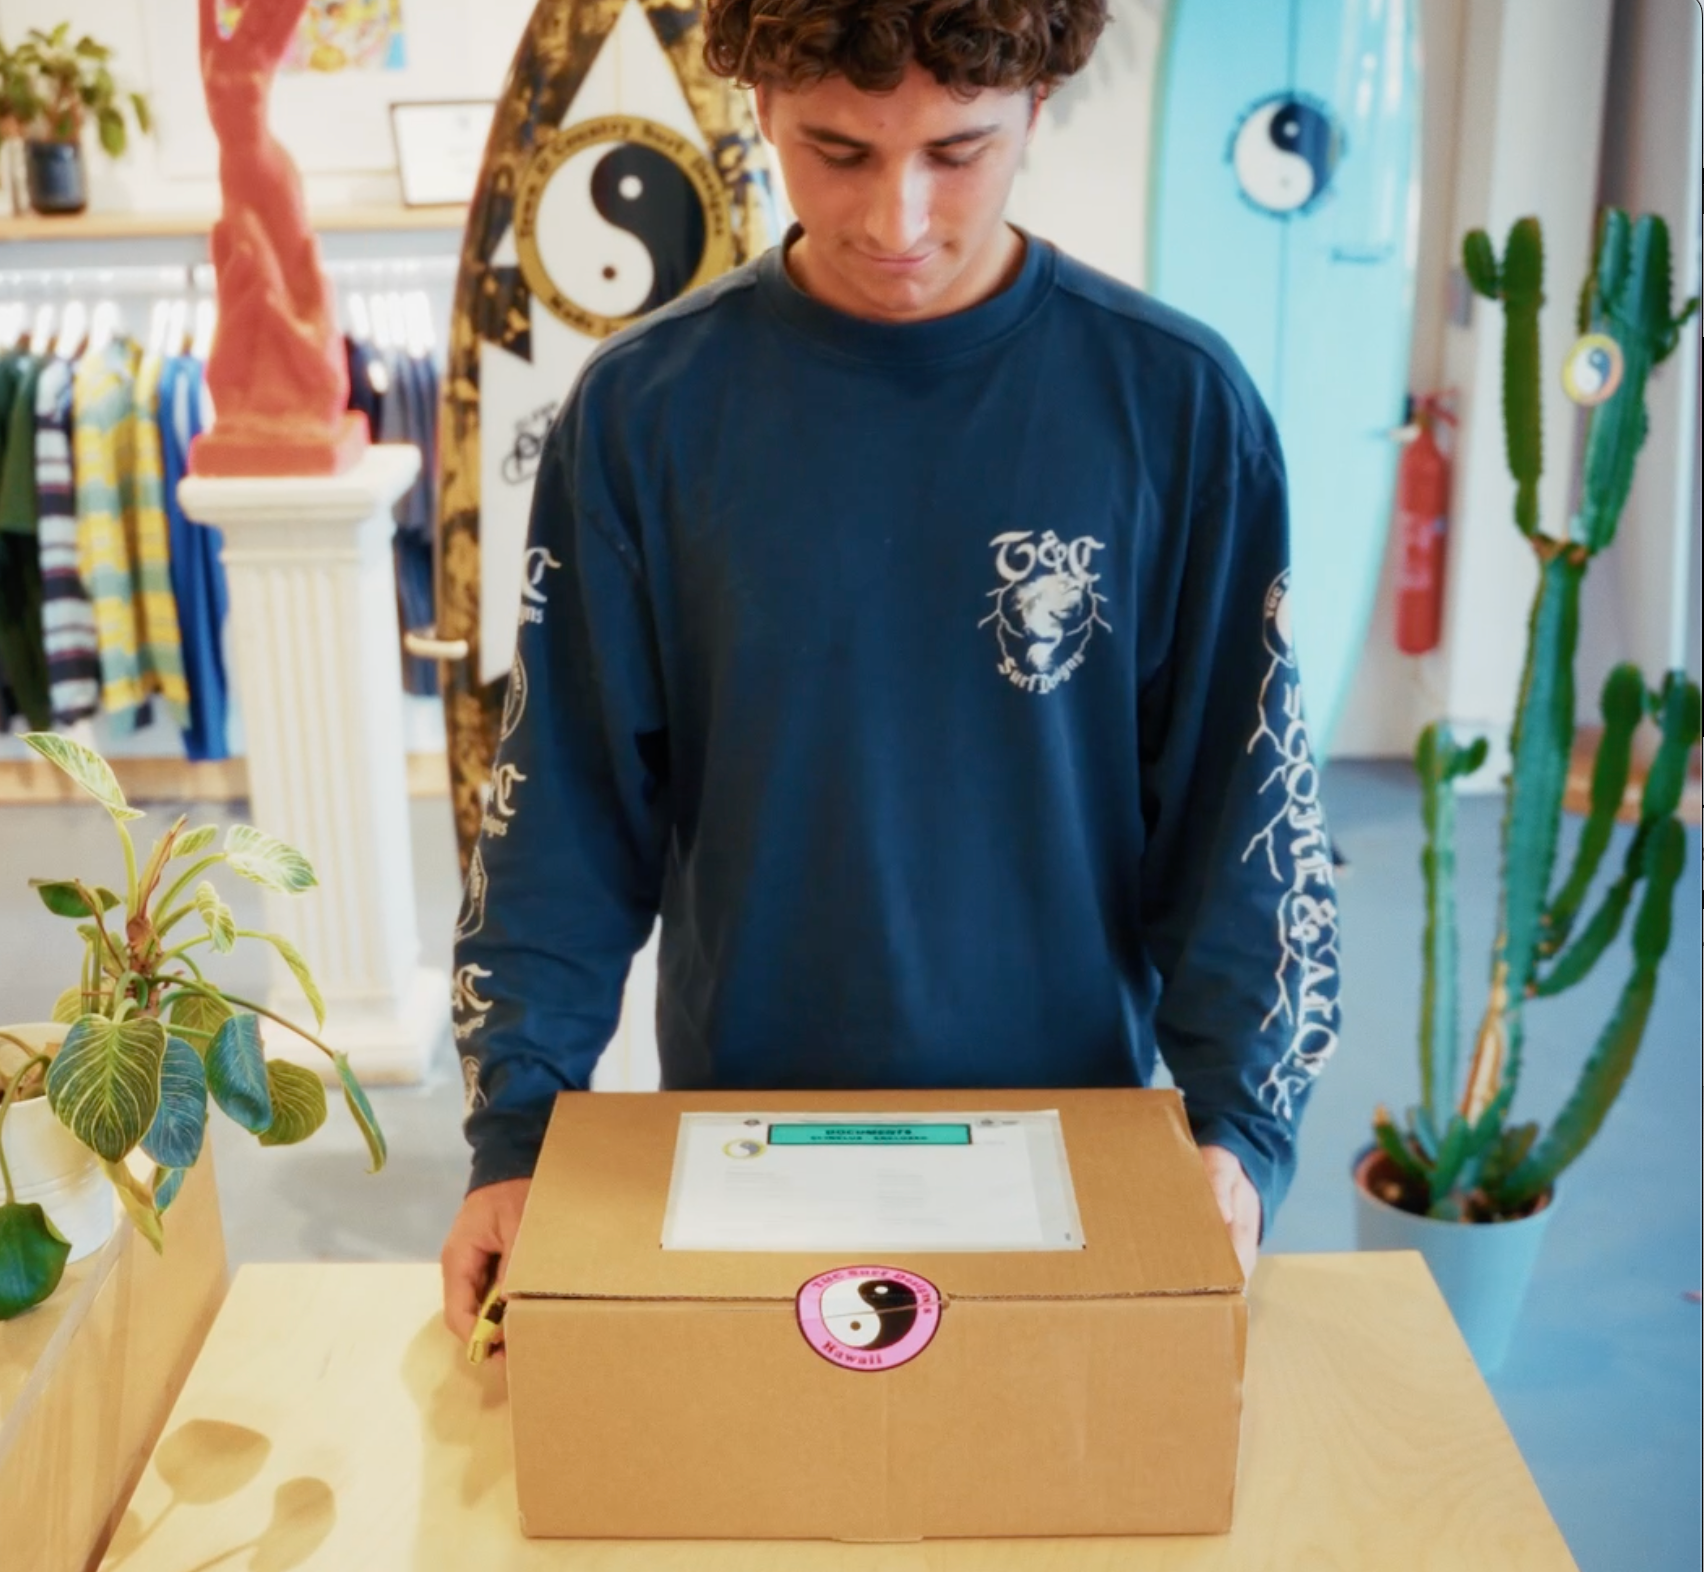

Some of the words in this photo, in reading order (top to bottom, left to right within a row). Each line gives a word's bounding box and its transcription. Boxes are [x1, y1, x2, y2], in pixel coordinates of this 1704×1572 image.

[551, 123, 631, 155] Country
[989, 529, 1106, 582] T&C
[998, 656, 1037, 692] Surf
[825, 1128, 913, 1136] DOCUMENTS
[848, 1269, 889, 1277] Surf
[893, 1273, 933, 1314] Designs
[822, 1340, 883, 1364] Hawaii
